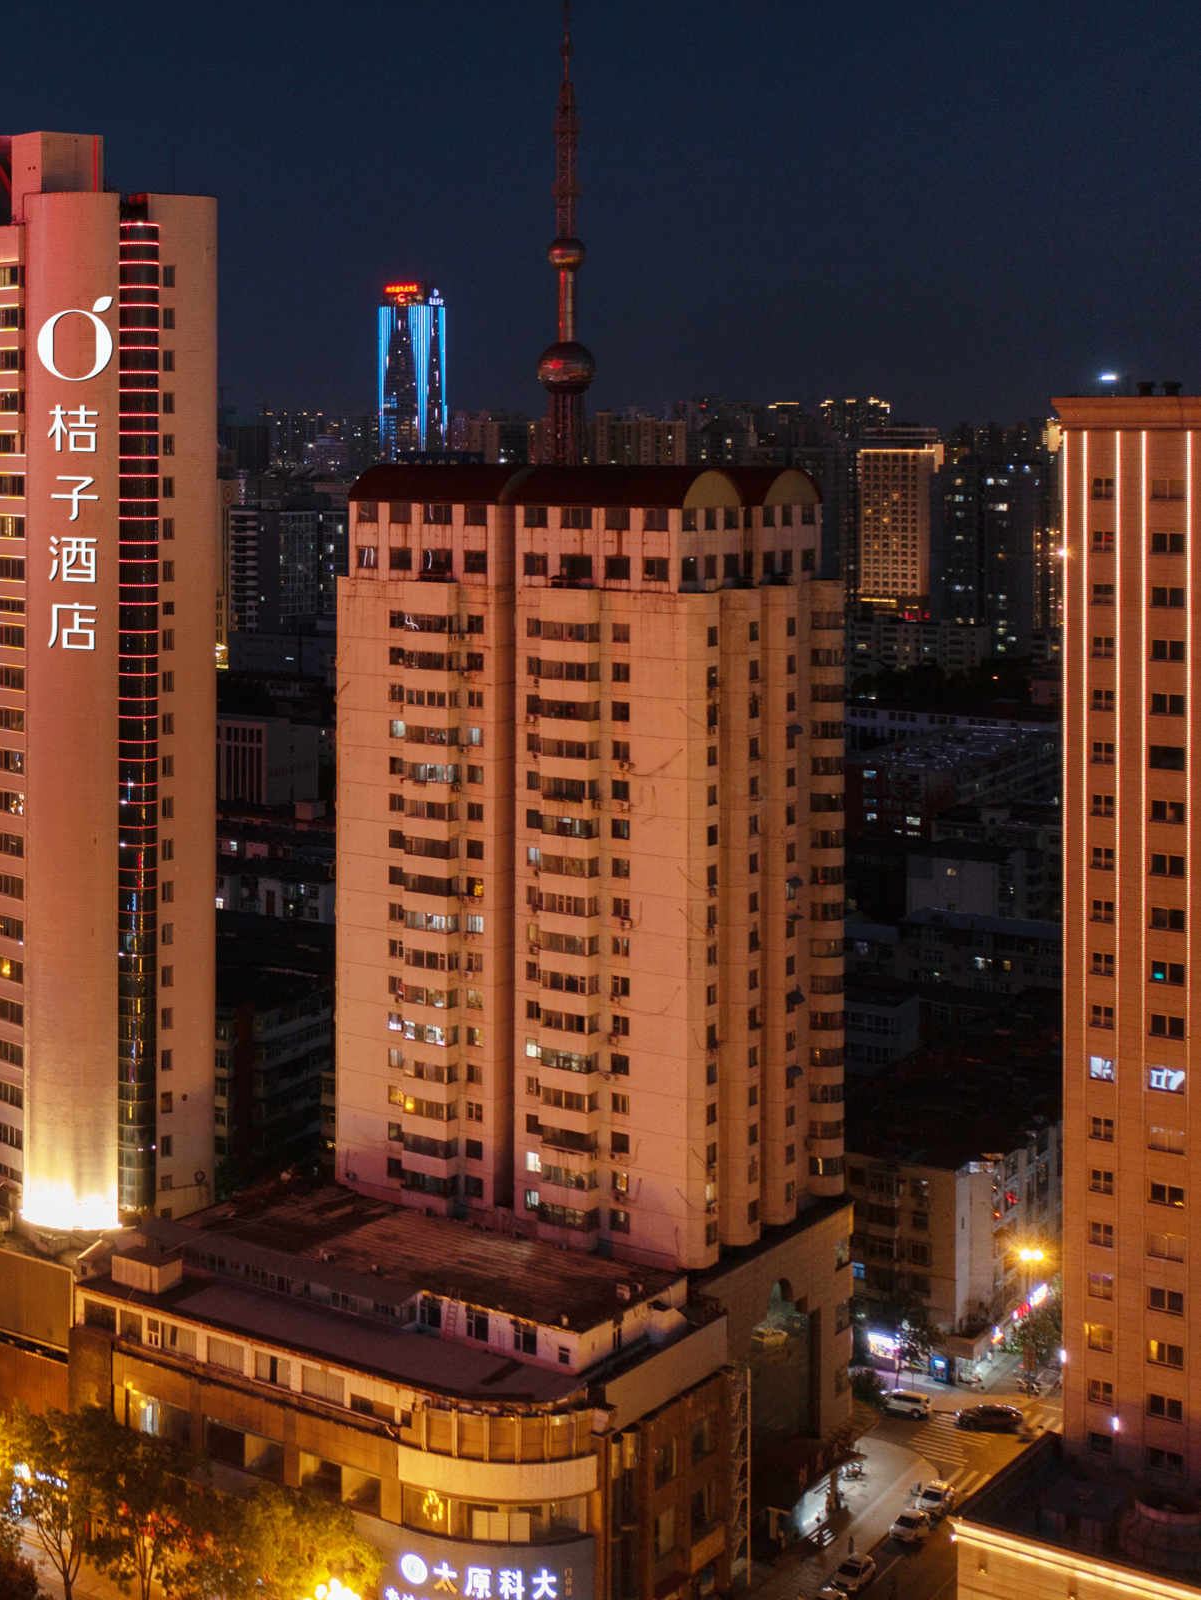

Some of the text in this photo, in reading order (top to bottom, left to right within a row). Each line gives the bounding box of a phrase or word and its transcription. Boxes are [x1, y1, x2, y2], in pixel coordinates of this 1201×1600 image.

[48, 404, 100, 651] 桔子酒店
[432, 1561, 558, 1600] 太原科大
